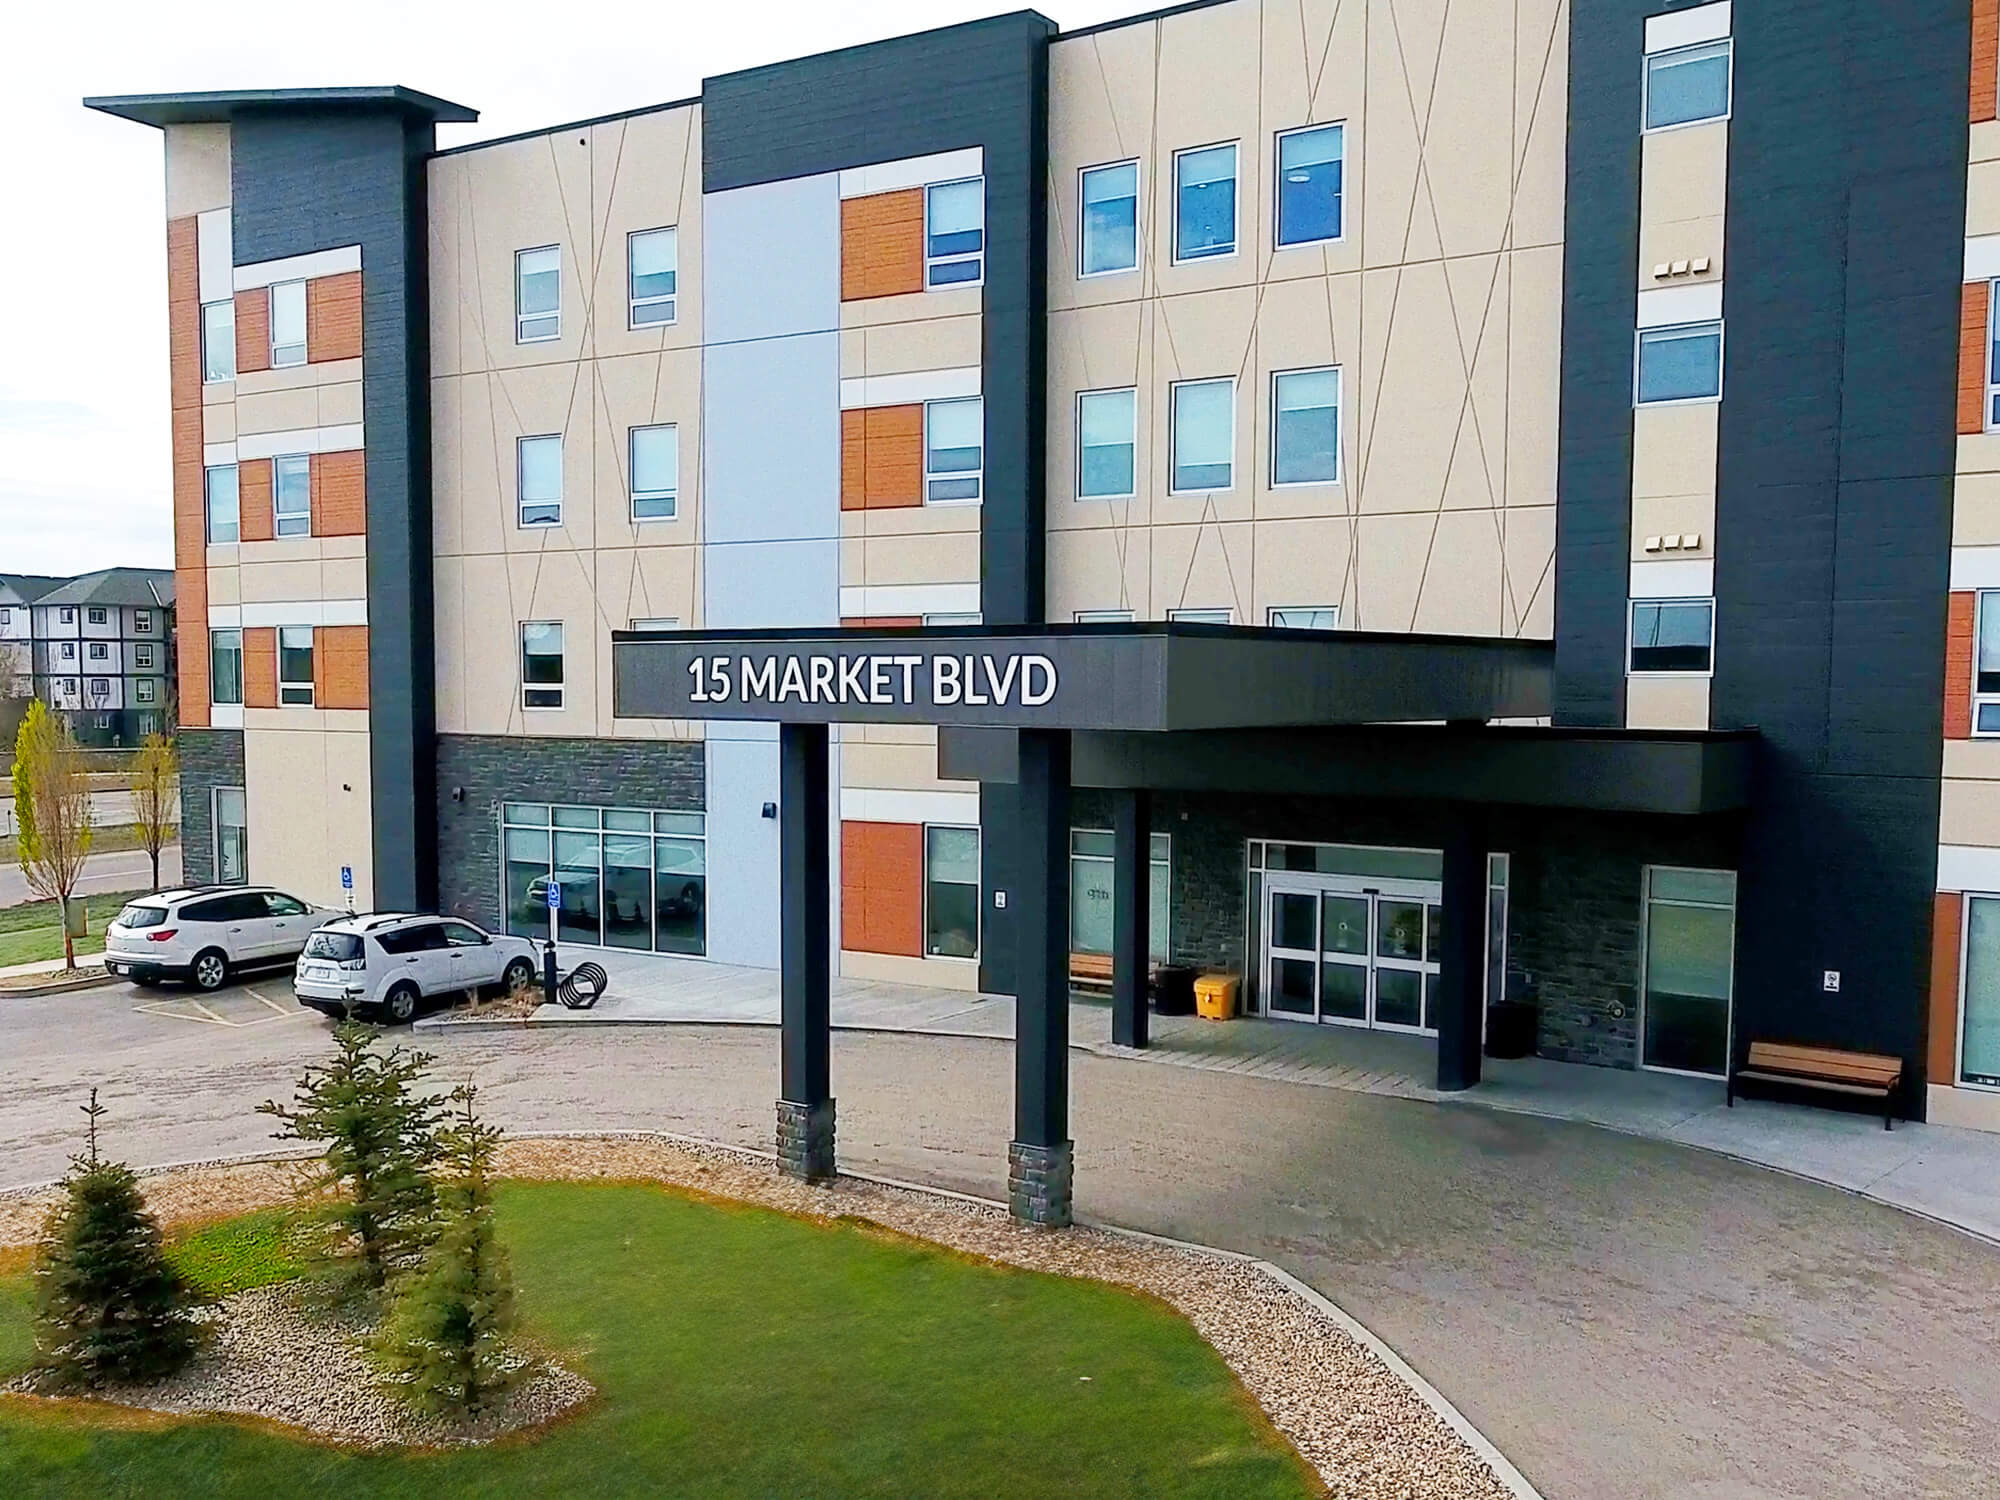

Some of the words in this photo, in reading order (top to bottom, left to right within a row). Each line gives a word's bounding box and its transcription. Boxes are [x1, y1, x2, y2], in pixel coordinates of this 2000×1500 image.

[687, 656, 731, 701] 15
[740, 655, 923, 704] MARKET
[932, 655, 1058, 706] BLVD
